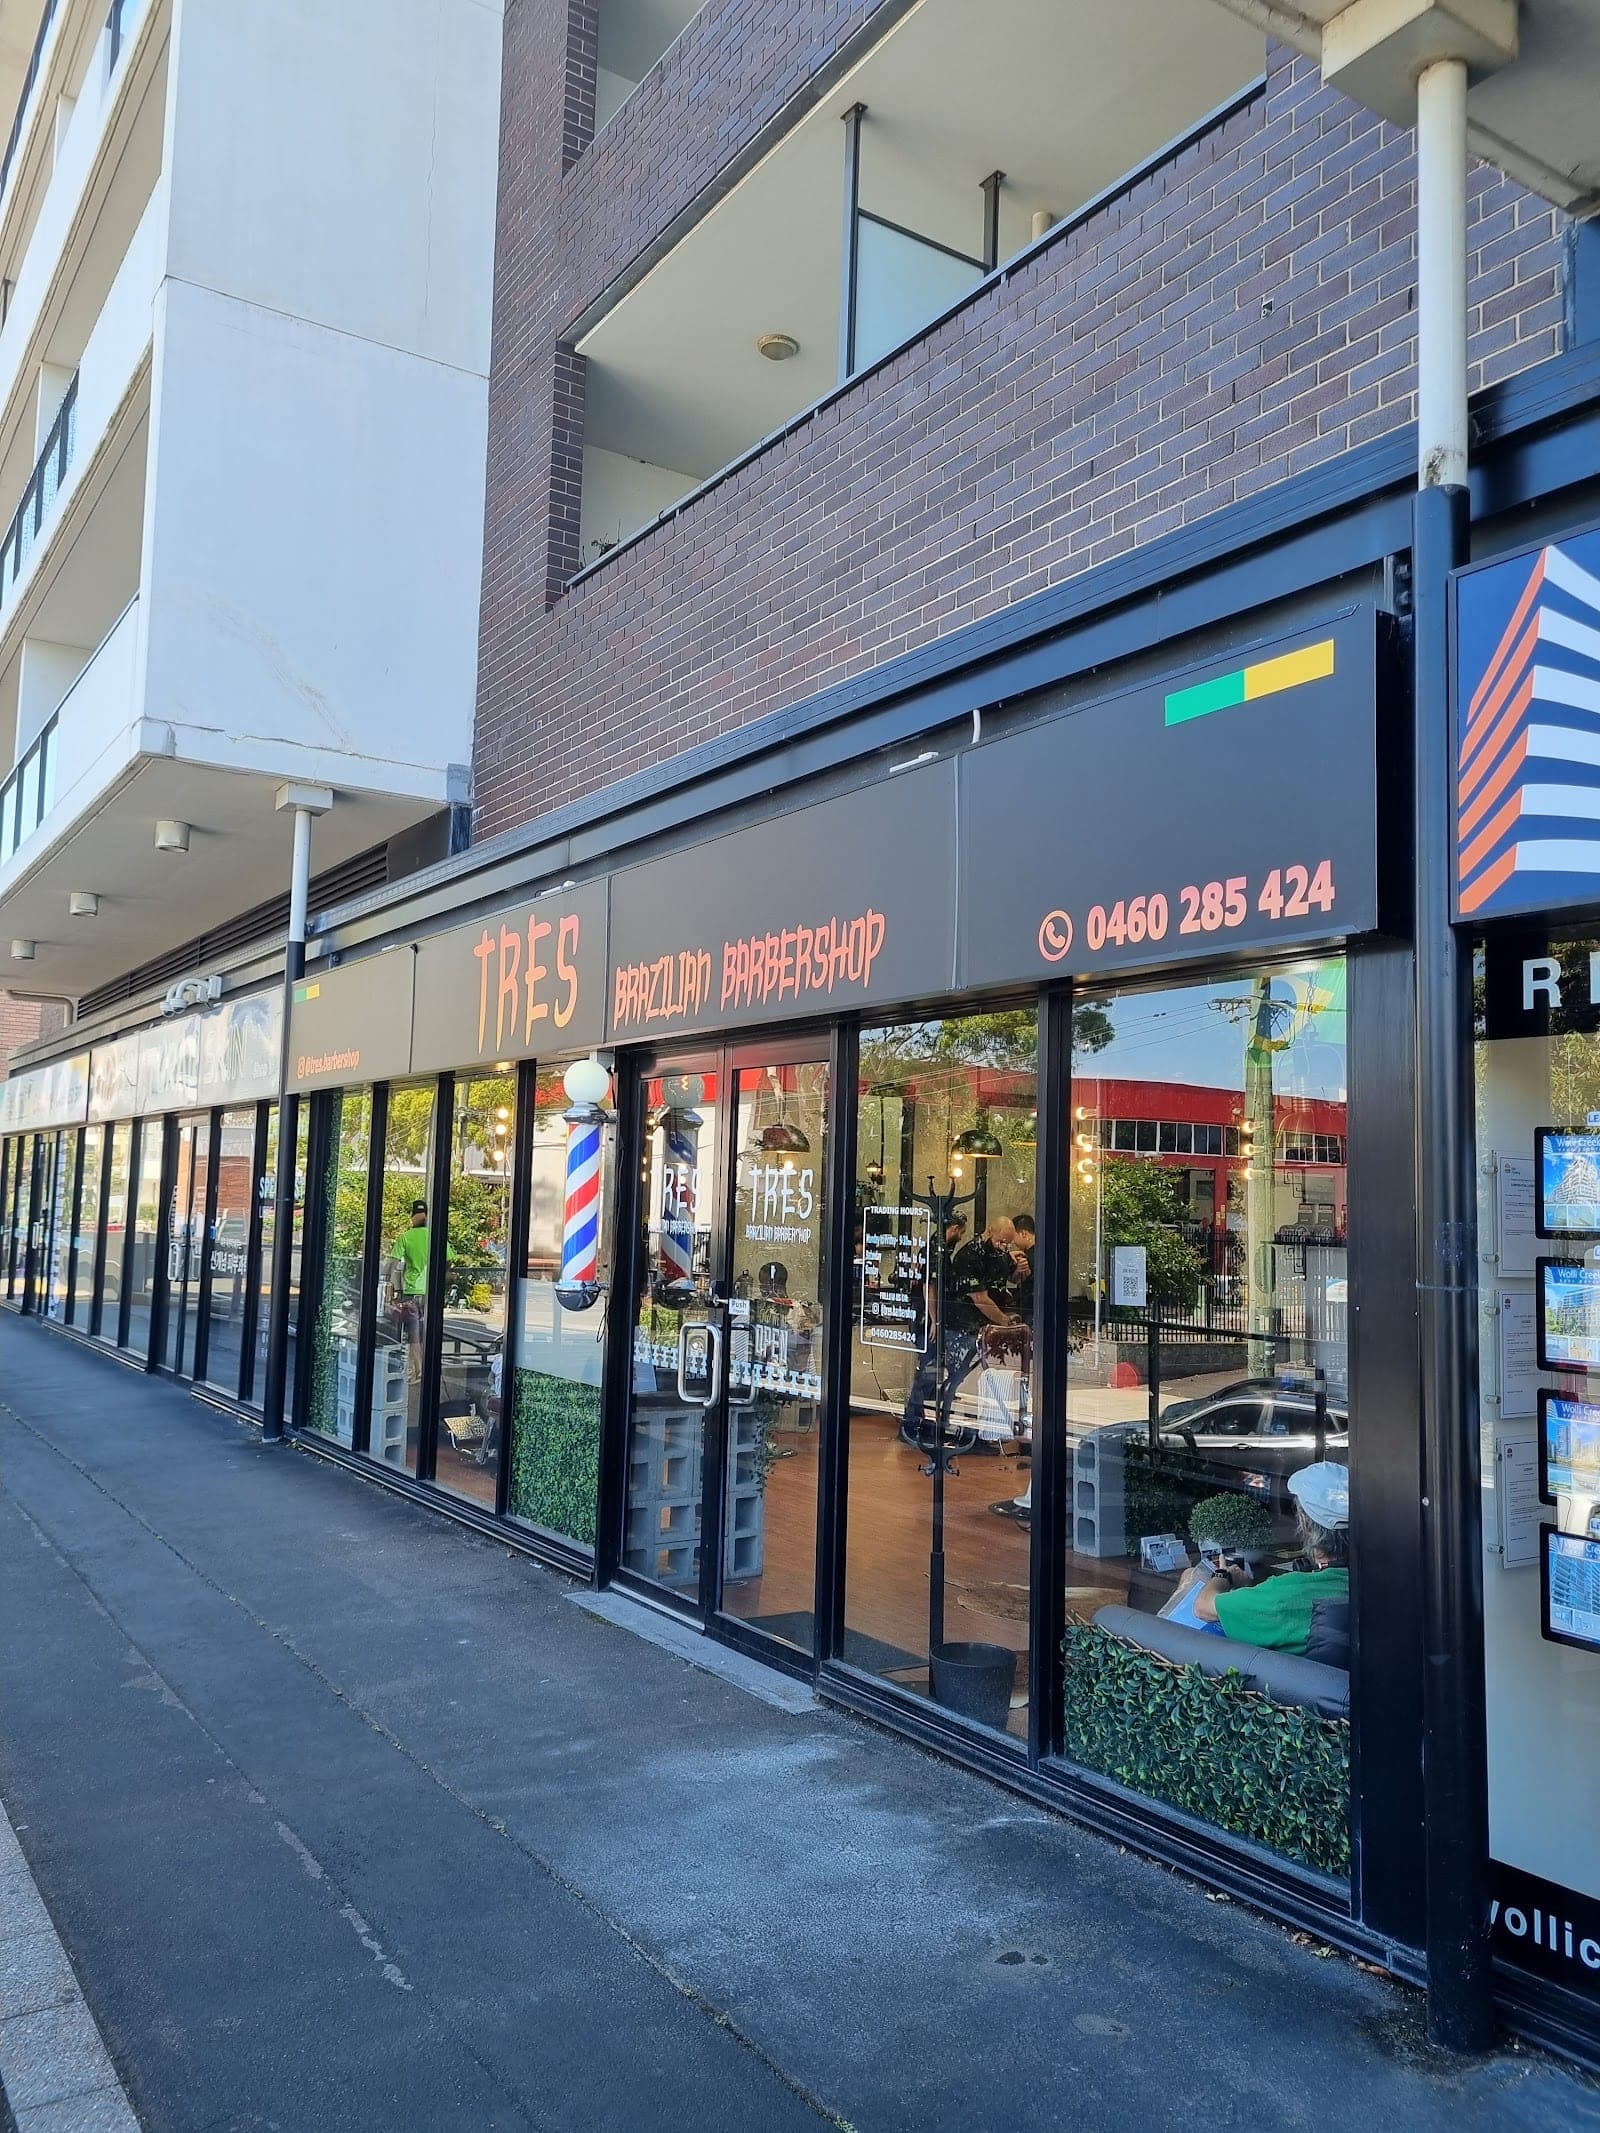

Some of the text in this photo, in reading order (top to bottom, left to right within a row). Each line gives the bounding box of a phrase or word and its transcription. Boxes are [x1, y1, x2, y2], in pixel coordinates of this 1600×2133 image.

[1086, 859, 1336, 951] 0460 285 424
[612, 907, 887, 1032] BRAZILIAN BARBERSHOP
[472, 912, 581, 1056] TRES
[748, 1163, 814, 1225] TRES
[870, 1205, 924, 1216] TRADING HOURS
[1558, 1268, 1577, 1279] Wolli
[731, 1300, 747, 1309] Push
[755, 1323, 788, 1363] OPEN
[871, 1327, 917, 1343] 0460285424
[1561, 1402, 1581, 1414] Wolli
